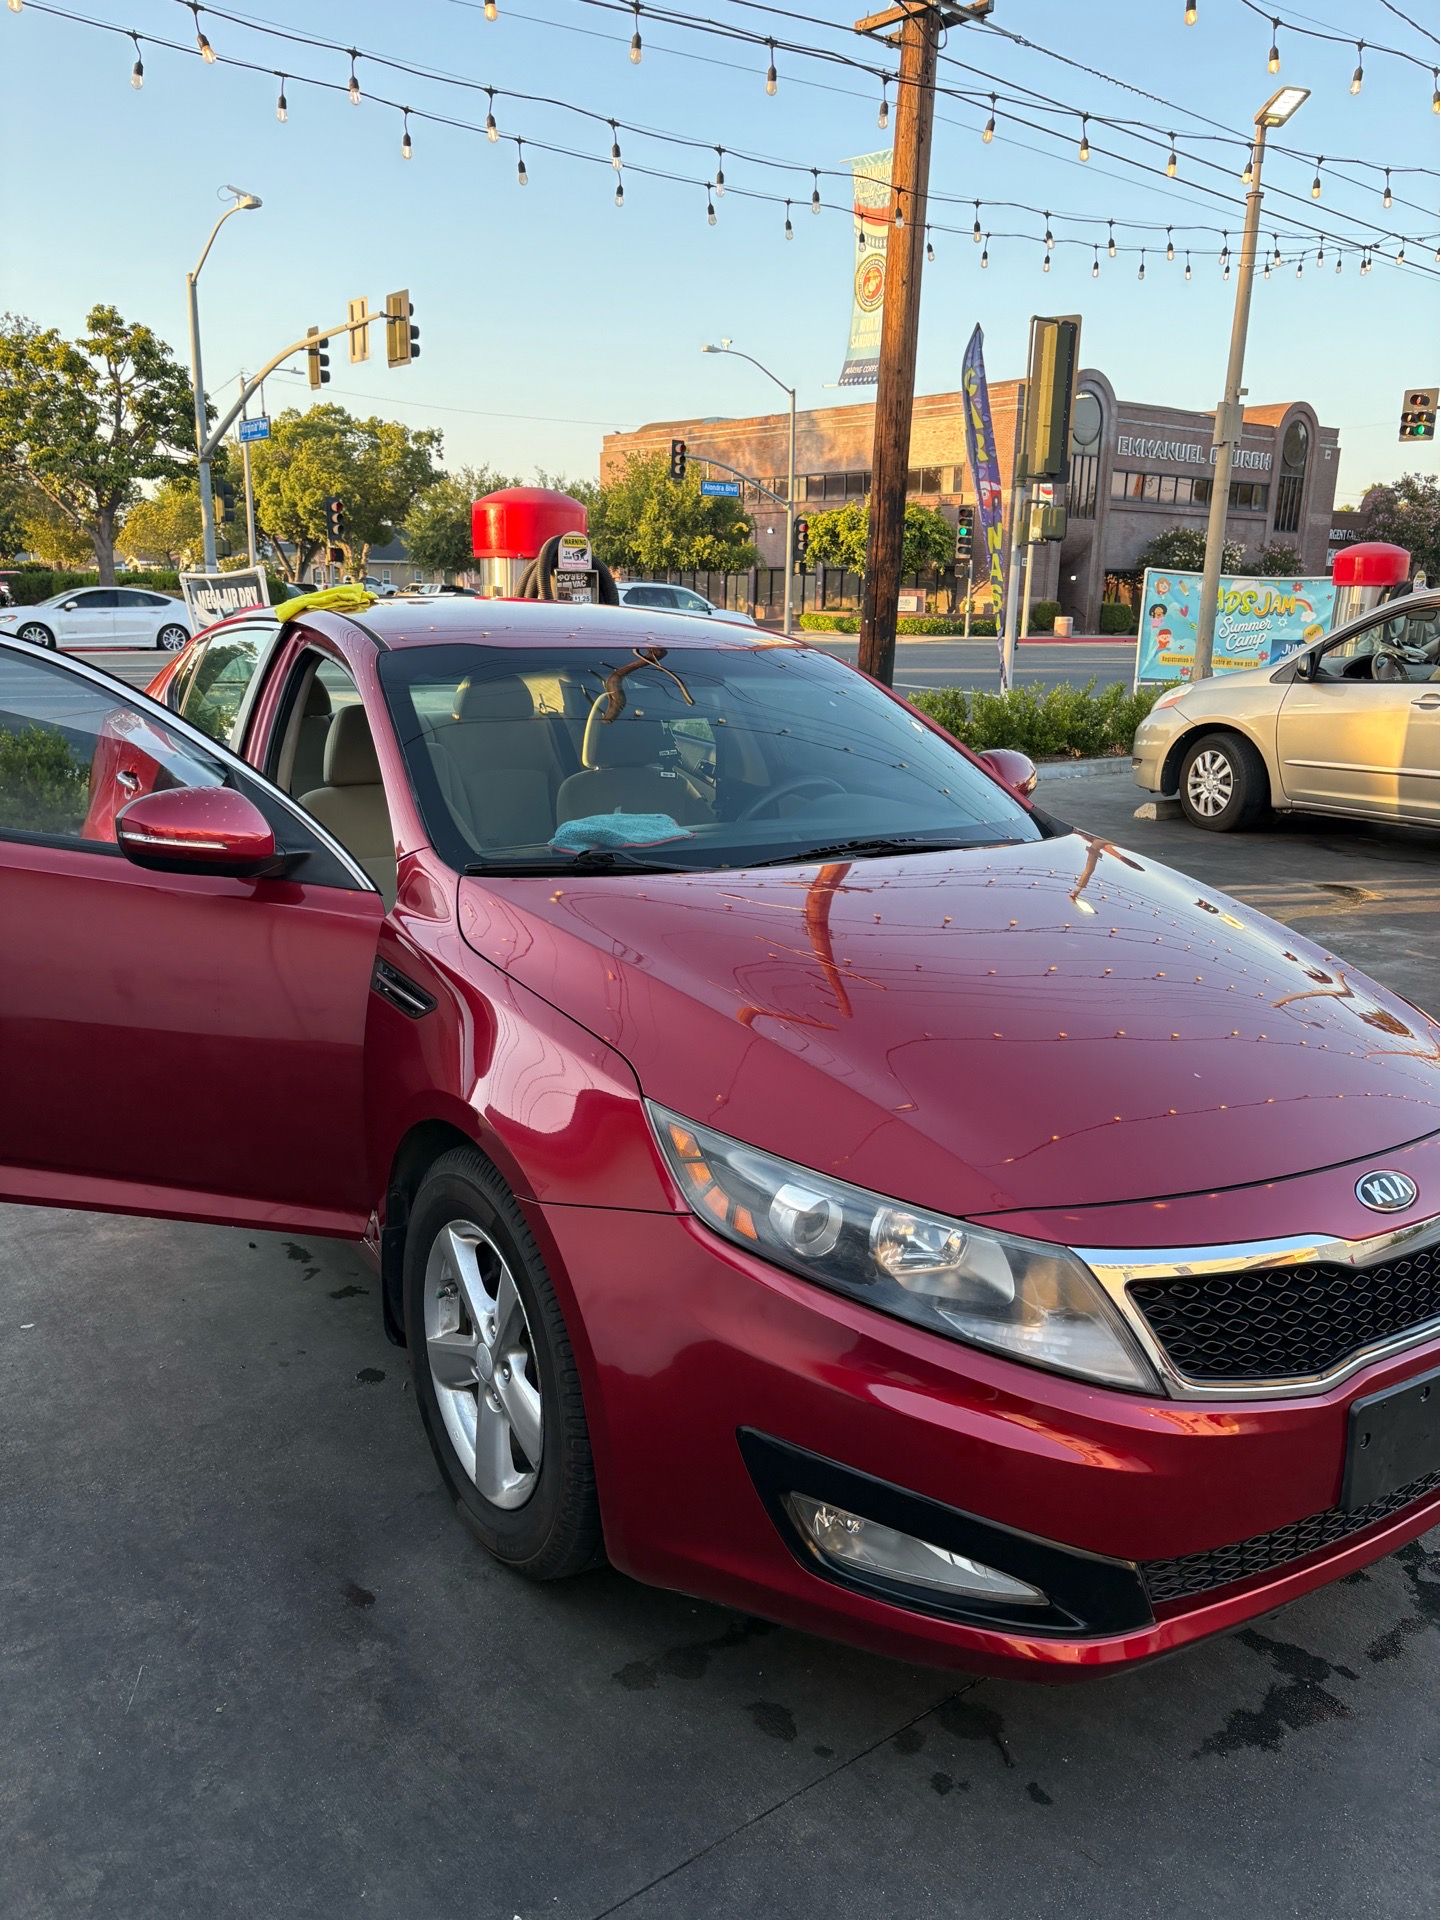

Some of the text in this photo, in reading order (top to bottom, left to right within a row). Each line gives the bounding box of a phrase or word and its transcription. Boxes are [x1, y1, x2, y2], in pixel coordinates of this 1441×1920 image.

[1117, 435, 1273, 471] EMMANUEL CURCH
[704, 483, 738, 492] Alondra Blvd
[572, 580, 587, 588] VAC
[196, 585, 259, 610] MEGA AIR DRY
[1254, 592, 1297, 618] JAM
[1219, 616, 1272, 639] Summer
[1225, 632, 1267, 652] Camp
[1363, 1175, 1414, 1205] KIA
